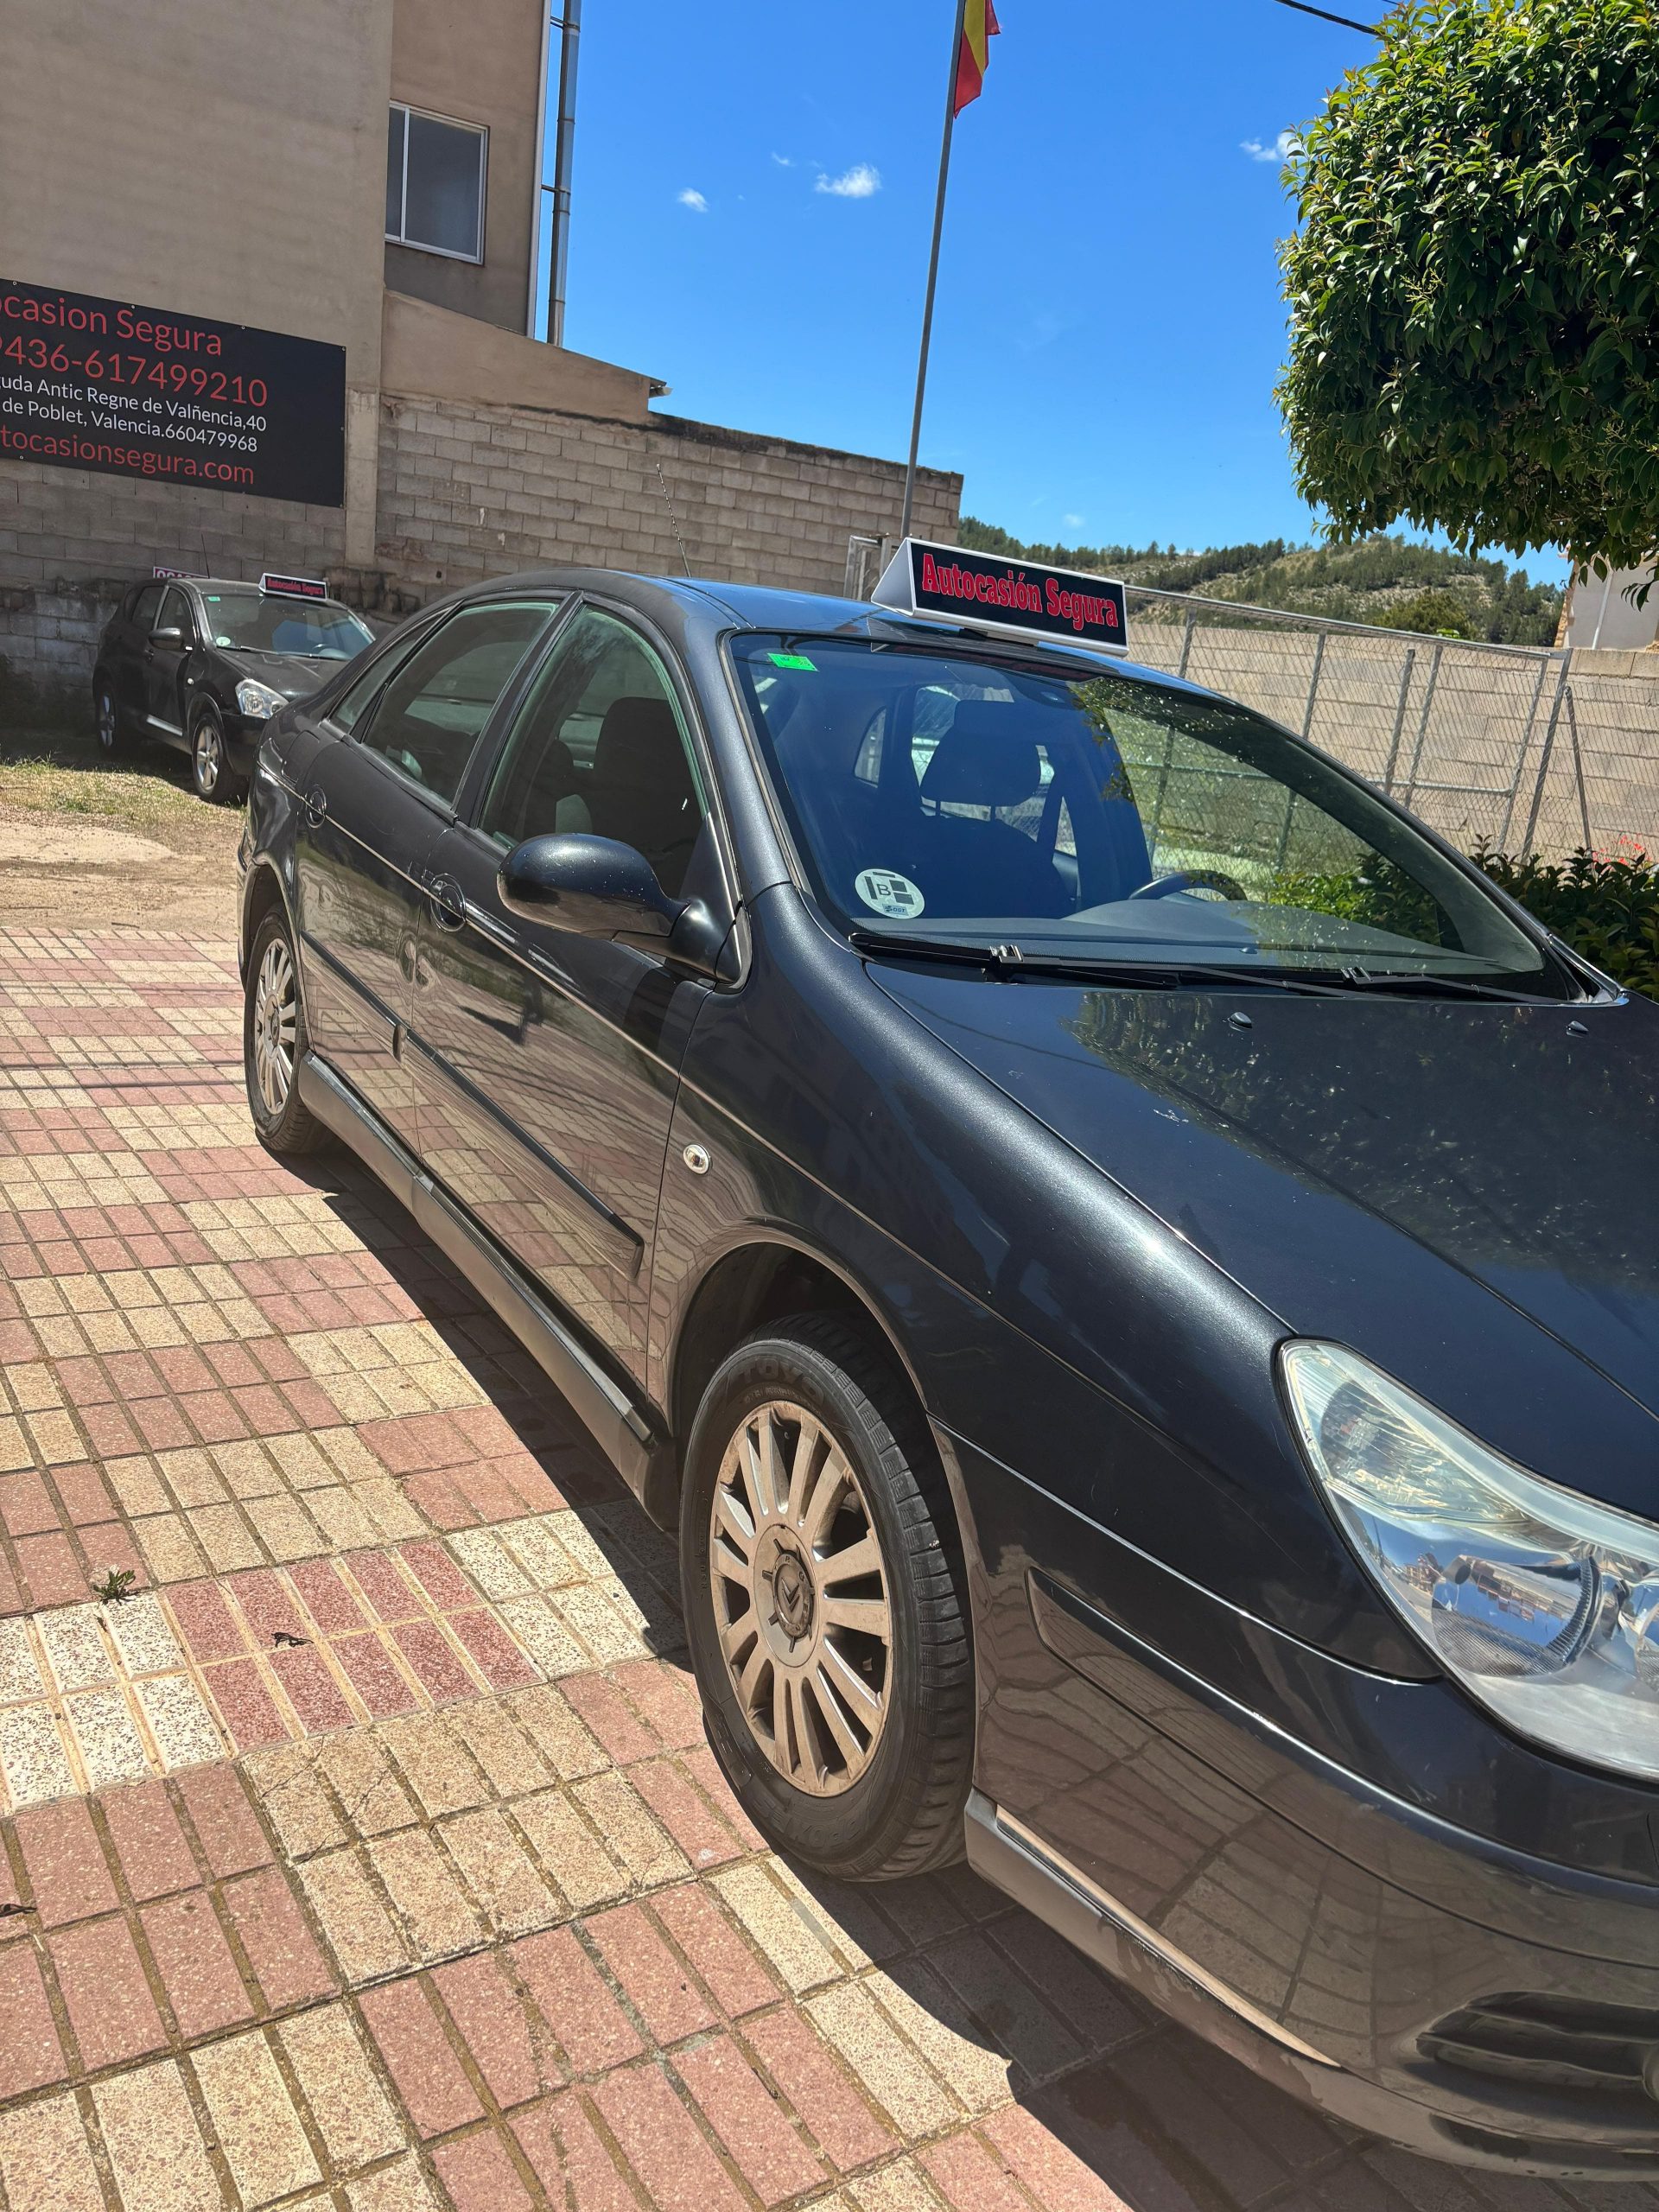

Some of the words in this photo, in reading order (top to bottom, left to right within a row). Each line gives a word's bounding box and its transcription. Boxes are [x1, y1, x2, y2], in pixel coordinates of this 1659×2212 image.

[0, 296, 107, 334] casion
[117, 309, 222, 356] Segura
[0, 375, 33, 392] uda
[37, 379, 83, 401] Antic
[87, 387, 138, 410] Regne
[143, 397, 162, 414] de
[166, 400, 267, 432] Valñencia,40
[3, 397, 23, 415] de
[29, 401, 87, 427] Poblet,
[92, 410, 257, 452] Valencia.660479968
[922, 553, 1042, 613] Autocasión
[1046, 578, 1118, 631] Segura
[876, 883, 891, 896] B
[733, 1356, 824, 1407] TOYO
